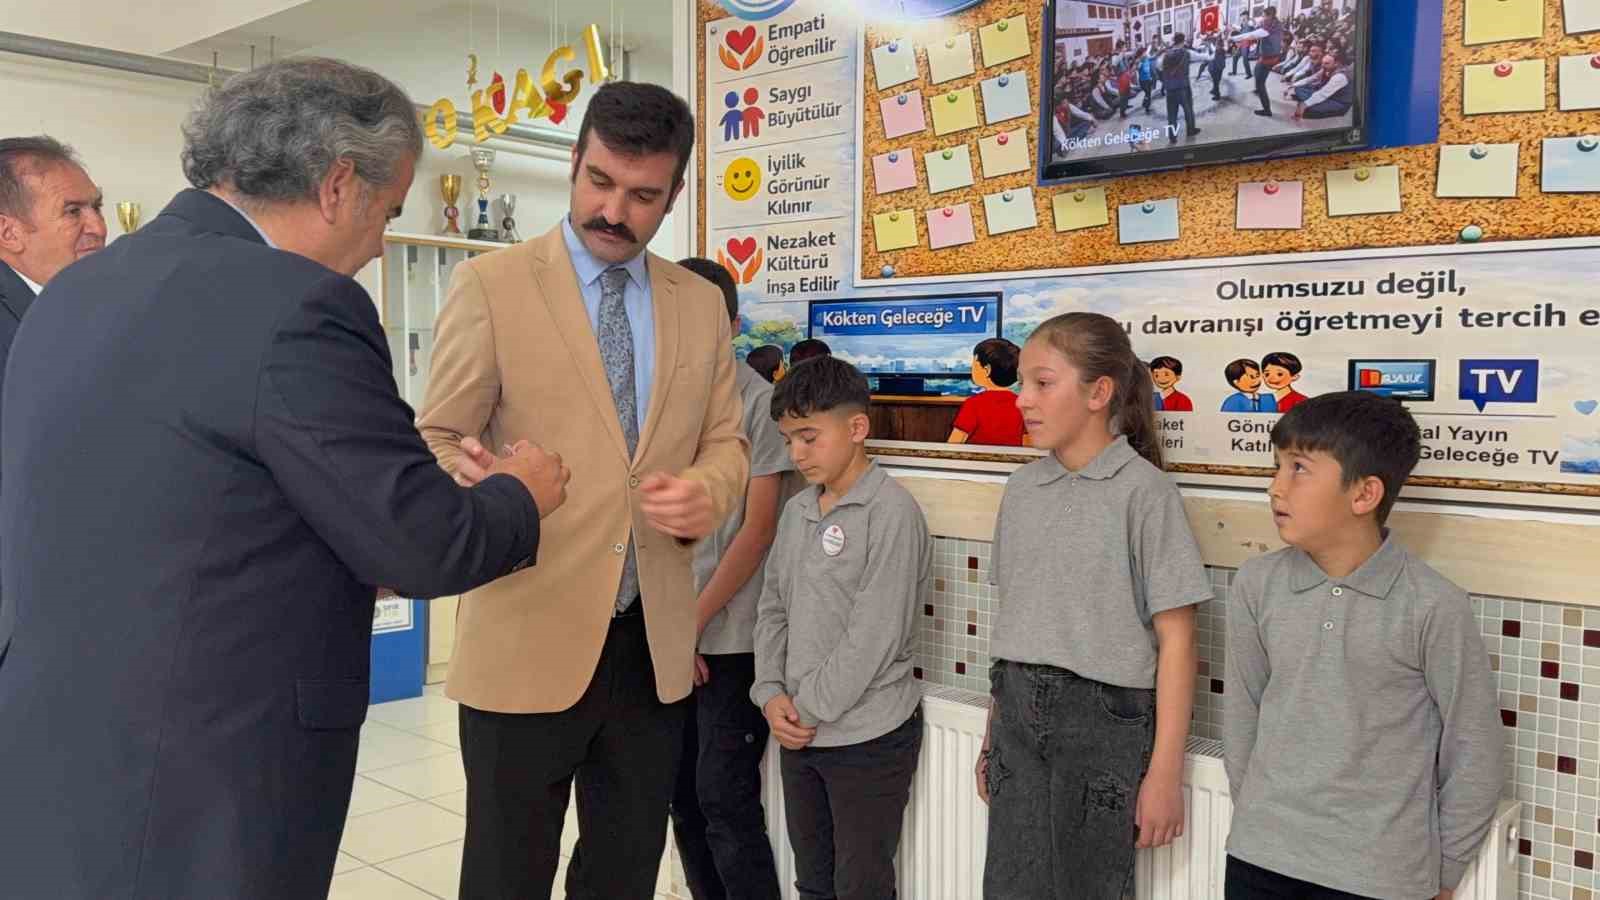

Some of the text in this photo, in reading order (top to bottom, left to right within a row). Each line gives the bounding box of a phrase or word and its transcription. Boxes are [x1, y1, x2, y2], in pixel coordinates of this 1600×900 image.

[768, 15, 825, 41] Empati
[768, 37, 837, 64] Öğrenilir
[768, 84, 812, 105] Saygı
[768, 103, 842, 129] Büyütülür
[1060, 124, 1181, 151] Kökten Geleceğe TV
[768, 153, 806, 176] İyilik
[768, 174, 830, 194] Görünür
[768, 199, 813, 216] Kılınır
[768, 231, 836, 251] Nezaket
[767, 253, 829, 272] Kültürü
[800, 276, 841, 292] Edilir
[1216, 269, 1466, 301] Olumsuzu değil,
[823, 305, 985, 328] Kökten Geleceğe TV
[1142, 314, 1264, 338] davranışı
[1276, 307, 1443, 337] öğretmeyi
[1458, 303, 1567, 328] tercih
[1469, 369, 1523, 394] TV
[1448, 426, 1508, 445] Yayın
[1418, 446, 1559, 466] Geleceğe TV
